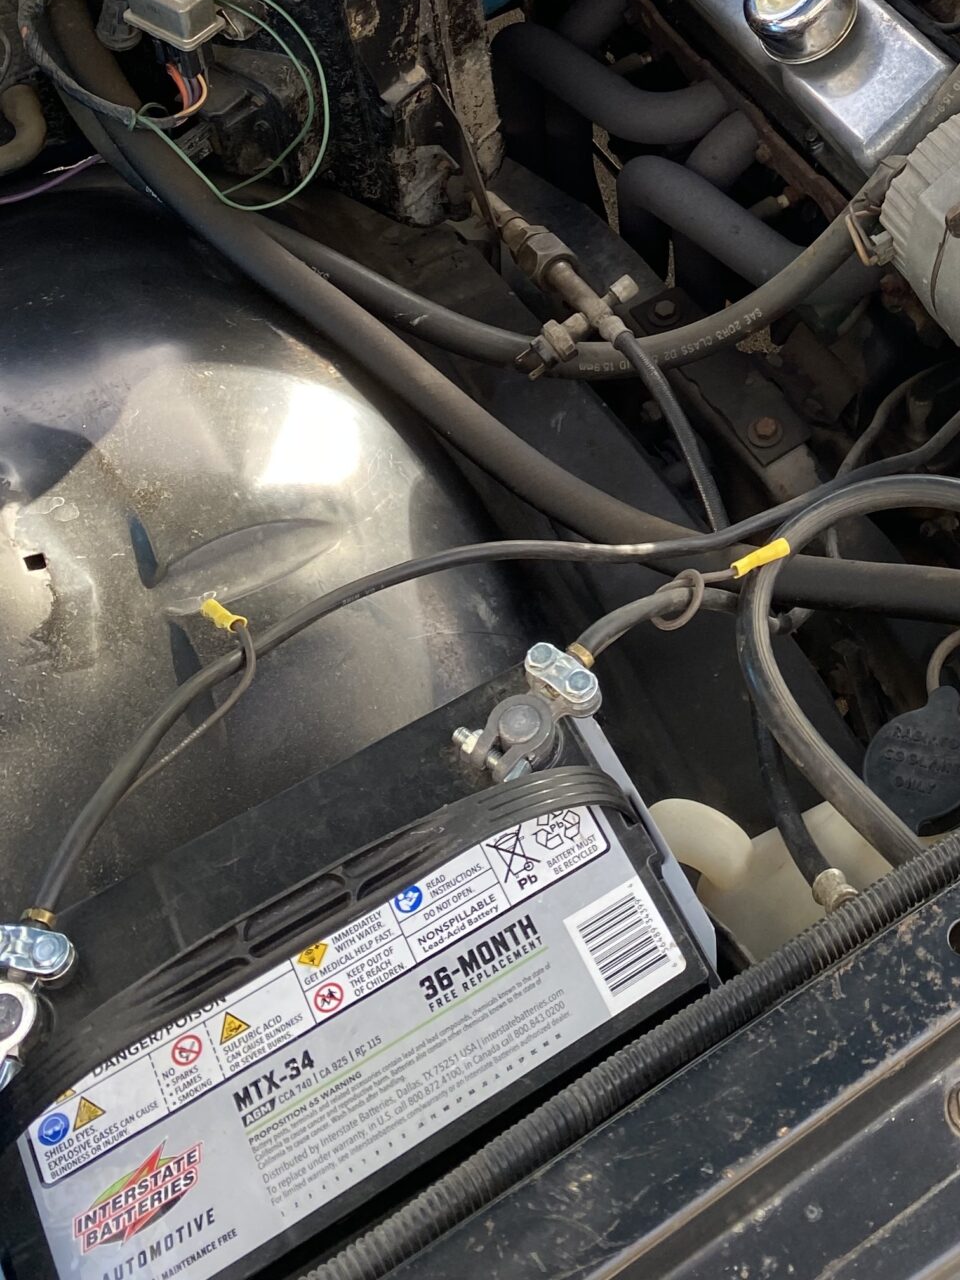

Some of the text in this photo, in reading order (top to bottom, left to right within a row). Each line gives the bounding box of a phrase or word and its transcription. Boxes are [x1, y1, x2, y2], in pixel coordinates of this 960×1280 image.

[682, 335, 713, 357] CLASS
[548, 818, 565, 833] Pb
[545, 833, 597, 868] BATTERY MUST
[552, 843, 599, 875] BE RECYCLED
[425, 873, 446, 890] READ
[429, 861, 484, 898] INSTRUCTIONS.
[516, 871, 538, 891] Pb
[330, 909, 383, 945] IMMEDIATELY
[416, 893, 497, 946] NONSPILLABLE
[421, 902, 500, 953] Lead-Acid Battery
[422, 908, 436, 920] DO
[435, 898, 452, 913] NOT
[303, 971, 320, 987] GET
[318, 949, 357, 977] MEDICAL
[353, 938, 375, 956] HELP
[334, 935, 358, 954] WITH
[345, 945, 394, 980] KEEP OUT OF
[417, 913, 539, 1001] 36-MONTH
[349, 958, 392, 988] THE REACH
[353, 985, 366, 998] OF
[427, 934, 544, 1012] FREE REPLACEMENT
[221, 1013, 283, 1056] SULFURIC ACID
[225, 1012, 303, 1064] CAN CAUSE BLINDNESS
[161, 1066, 176, 1081] NO
[170, 1064, 199, 1086] SPARKS
[228, 1060, 241, 1073] OR
[239, 1044, 267, 1066] SEVERE
[173, 1072, 203, 1095] FLAMES
[176, 1077, 212, 1104] SMOKING
[231, 1047, 316, 1113] MTX-34
[243, 1101, 273, 1126] AGM
[277, 1087, 296, 1105] CCA
[294, 1077, 312, 1094] 740
[318, 1065, 331, 1079] CA
[366, 1034, 382, 1050] 115
[261, 986, 565, 1184] Distributed by Interstate Batteries, Dallas, TX 75251 USA interstatebatteries.com
[266, 1182, 278, 1196] To
[276, 1164, 308, 1192] replace
[306, 1148, 332, 1171] under
[330, 1125, 368, 1157] warranty,
[367, 1120, 377, 1132] in
[392, 1099, 408, 1115] call
[462, 1058, 473, 1070] in
[471, 1040, 501, 1065] Canada
[499, 1031, 514, 1047] call
[512, 999, 566, 1039] 800.843.0200
[247, 1069, 362, 1146] PROPOSITION 65 WARNING
[43, 1136, 75, 1162] SHIELD
[47, 1099, 159, 1172] EXPLOSIVE GASES CAN CAUSE
[49, 1150, 91, 1180] BLINDNESS
[90, 1143, 102, 1156] OR
[74, 1148, 199, 1235] INTERSTATE
[83, 1168, 198, 1249] BATTERIES
[102, 1208, 216, 1280] AUTOMOTIVE
[161, 1228, 238, 1280] MAINTENANCE FREE
